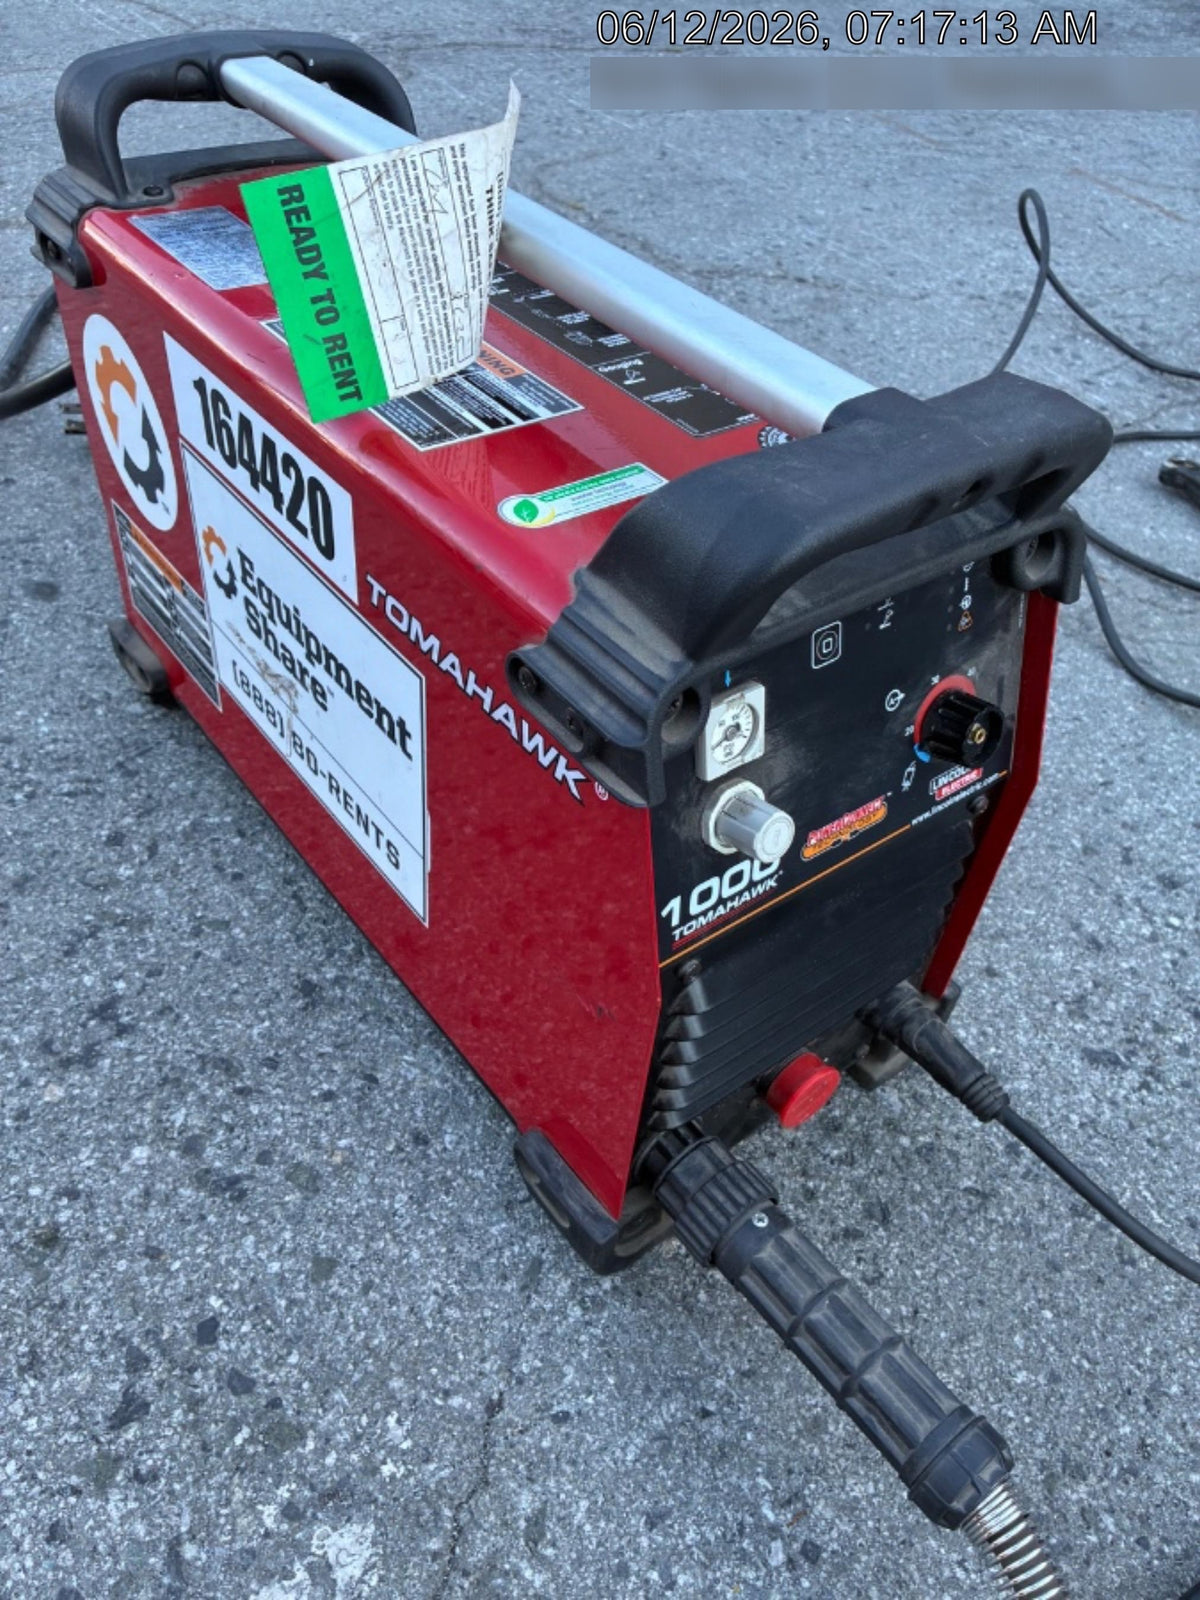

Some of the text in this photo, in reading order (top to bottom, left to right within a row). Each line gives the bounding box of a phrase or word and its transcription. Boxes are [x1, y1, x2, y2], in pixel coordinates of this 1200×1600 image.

[277, 183, 330, 282] READY
[310, 288, 341, 326] TO
[322, 332, 363, 402] RENT
[193, 376, 335, 561] 164420
[236, 546, 414, 762] Equipment
[243, 594, 329, 712] Share
[366, 573, 591, 806] TOMAHAWK
[932, 765, 972, 791] LINCOL
[671, 874, 778, 942] TOMAHAWK
